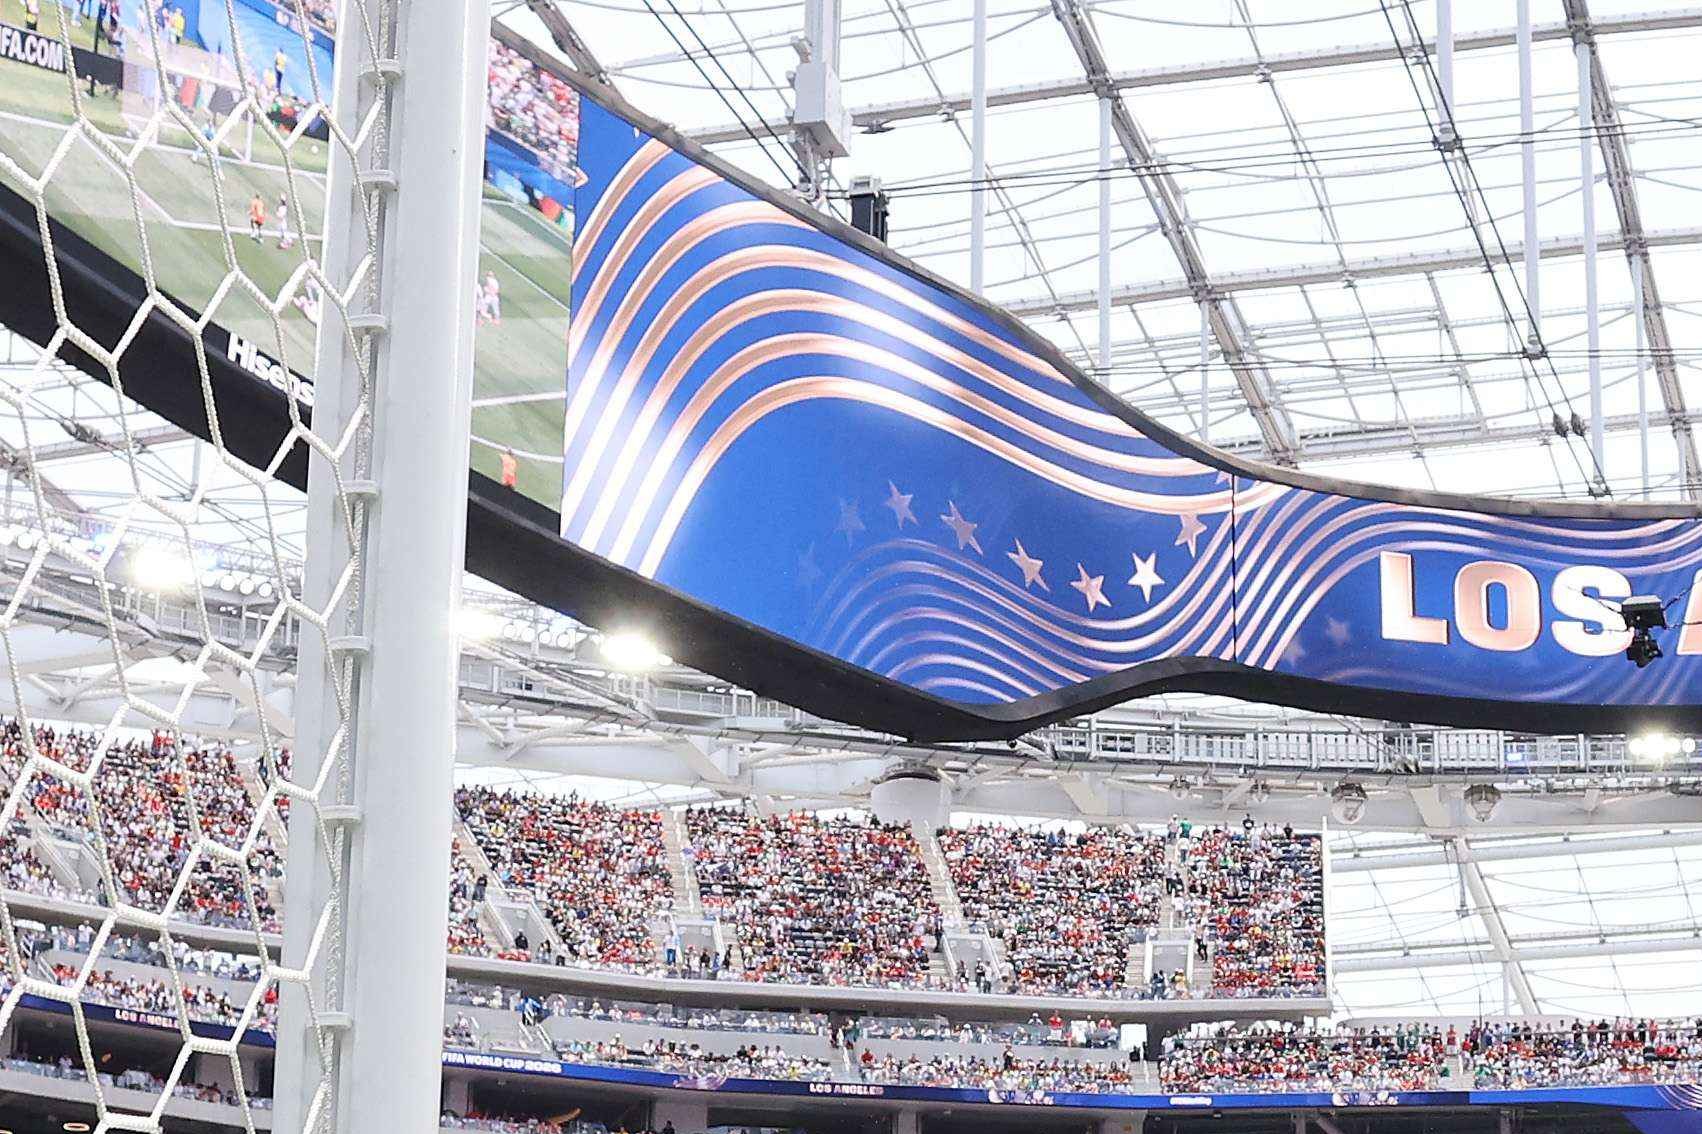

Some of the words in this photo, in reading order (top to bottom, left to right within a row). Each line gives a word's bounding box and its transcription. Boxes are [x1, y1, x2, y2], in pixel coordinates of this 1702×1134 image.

[0, 26, 64, 71] FA.COM
[227, 332, 315, 407] Hisens
[1379, 551, 1635, 657] LOS
[465, 1055, 503, 1067] WORLD
[503, 1058, 525, 1069] CUP
[809, 1083, 832, 1094] LOS
[834, 1084, 885, 1096] ANGELES
